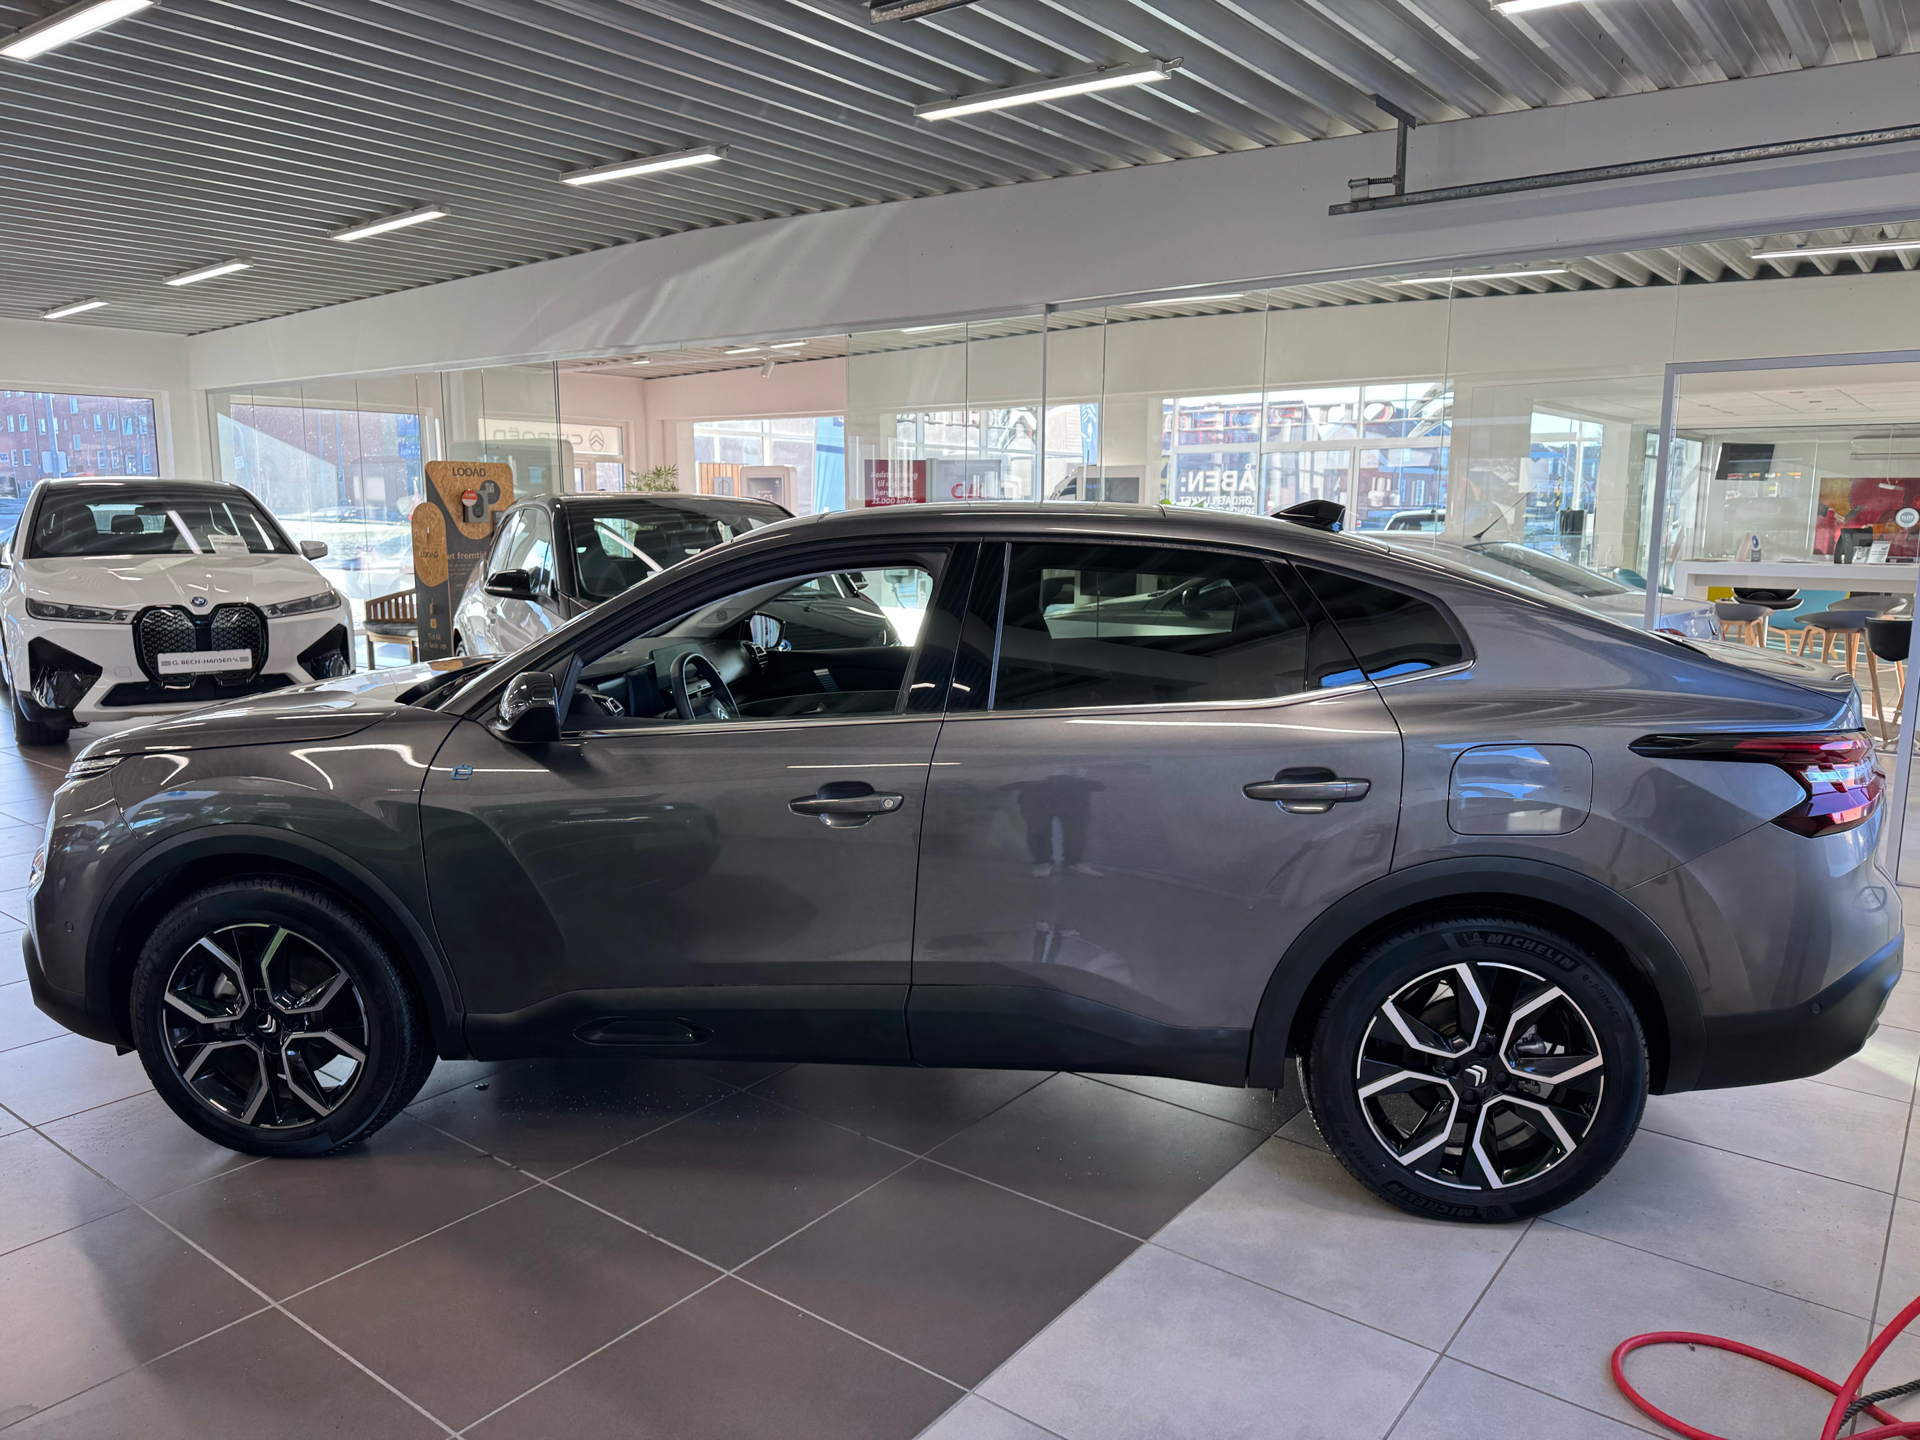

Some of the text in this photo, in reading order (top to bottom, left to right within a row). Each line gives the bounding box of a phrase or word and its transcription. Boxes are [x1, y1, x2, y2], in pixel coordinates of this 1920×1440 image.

[452, 467, 487, 477] LOOAD
[1487, 933, 1576, 969] MICHELIN
[1387, 1183, 1476, 1218] MICHELIN
